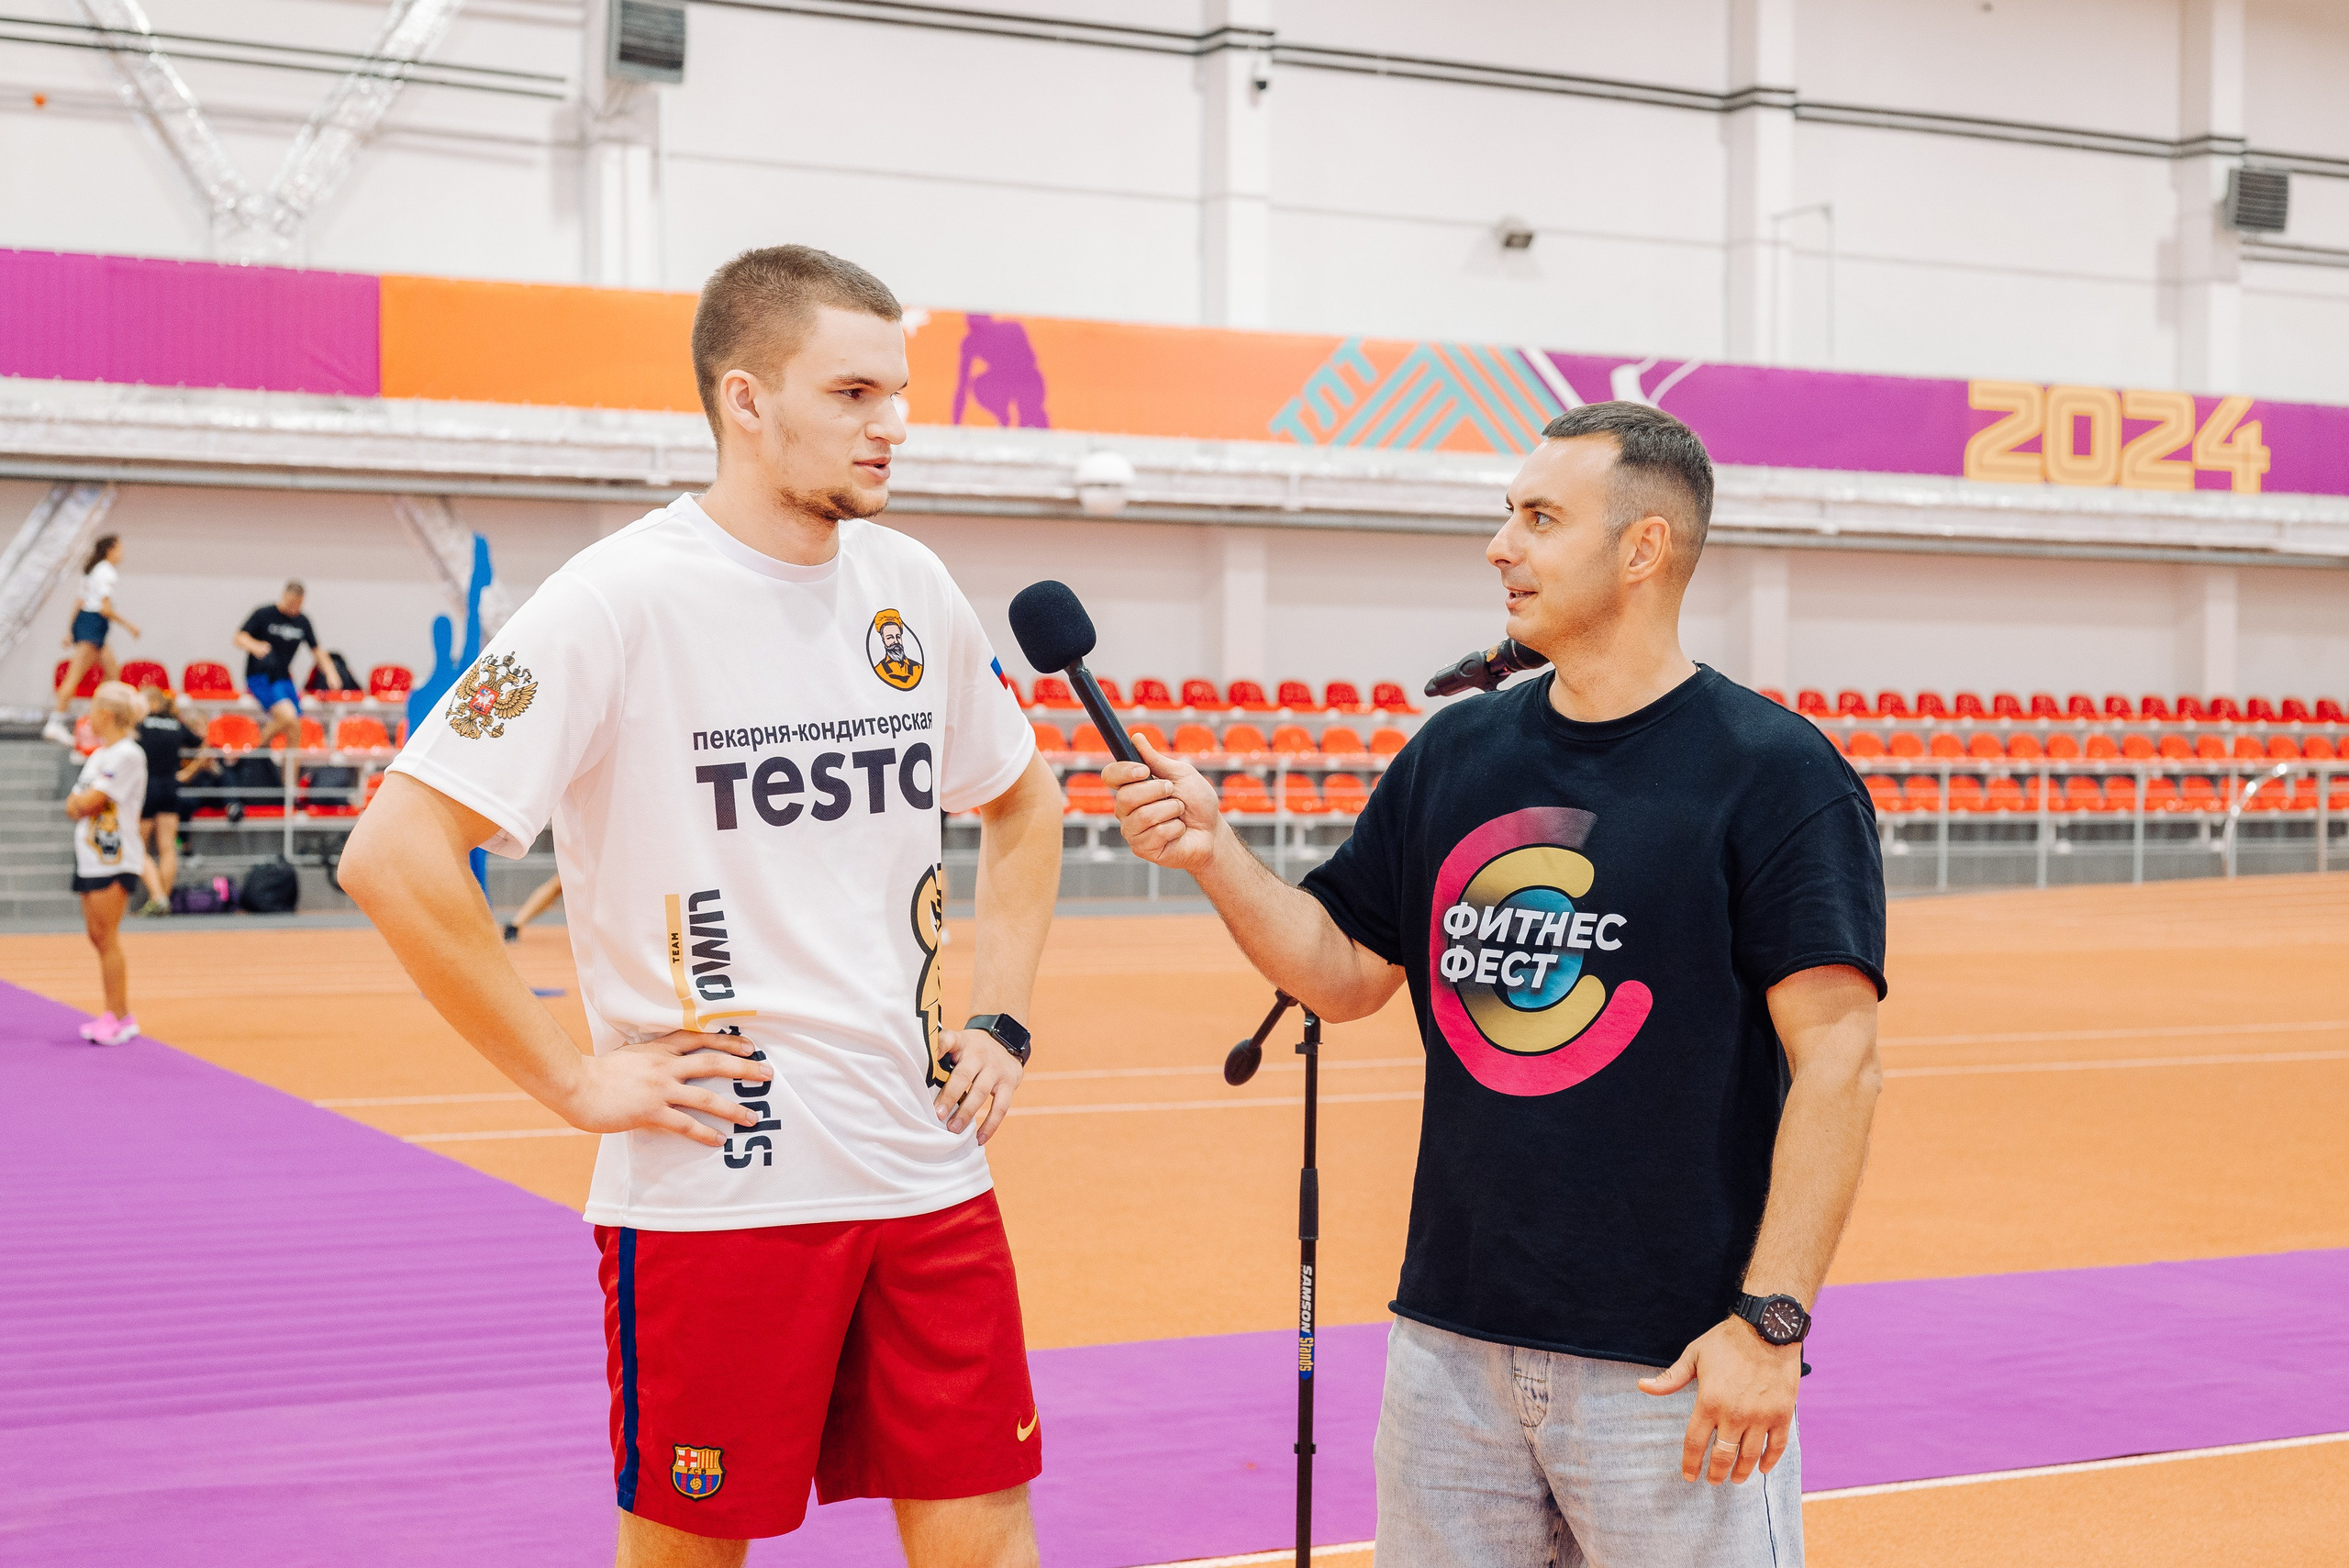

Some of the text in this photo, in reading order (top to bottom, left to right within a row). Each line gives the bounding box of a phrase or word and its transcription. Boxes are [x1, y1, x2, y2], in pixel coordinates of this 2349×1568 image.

[1965, 378, 2271, 494] 2024
[693, 710, 933, 751] пекарня-кондитерская
[671, 931, 680, 964] TEAM
[1442, 901, 1628, 951] ФИТНЕС
[1440, 945, 1559, 989] ФЕСТ
[1298, 1264, 1315, 1372] SAMSON Stands
